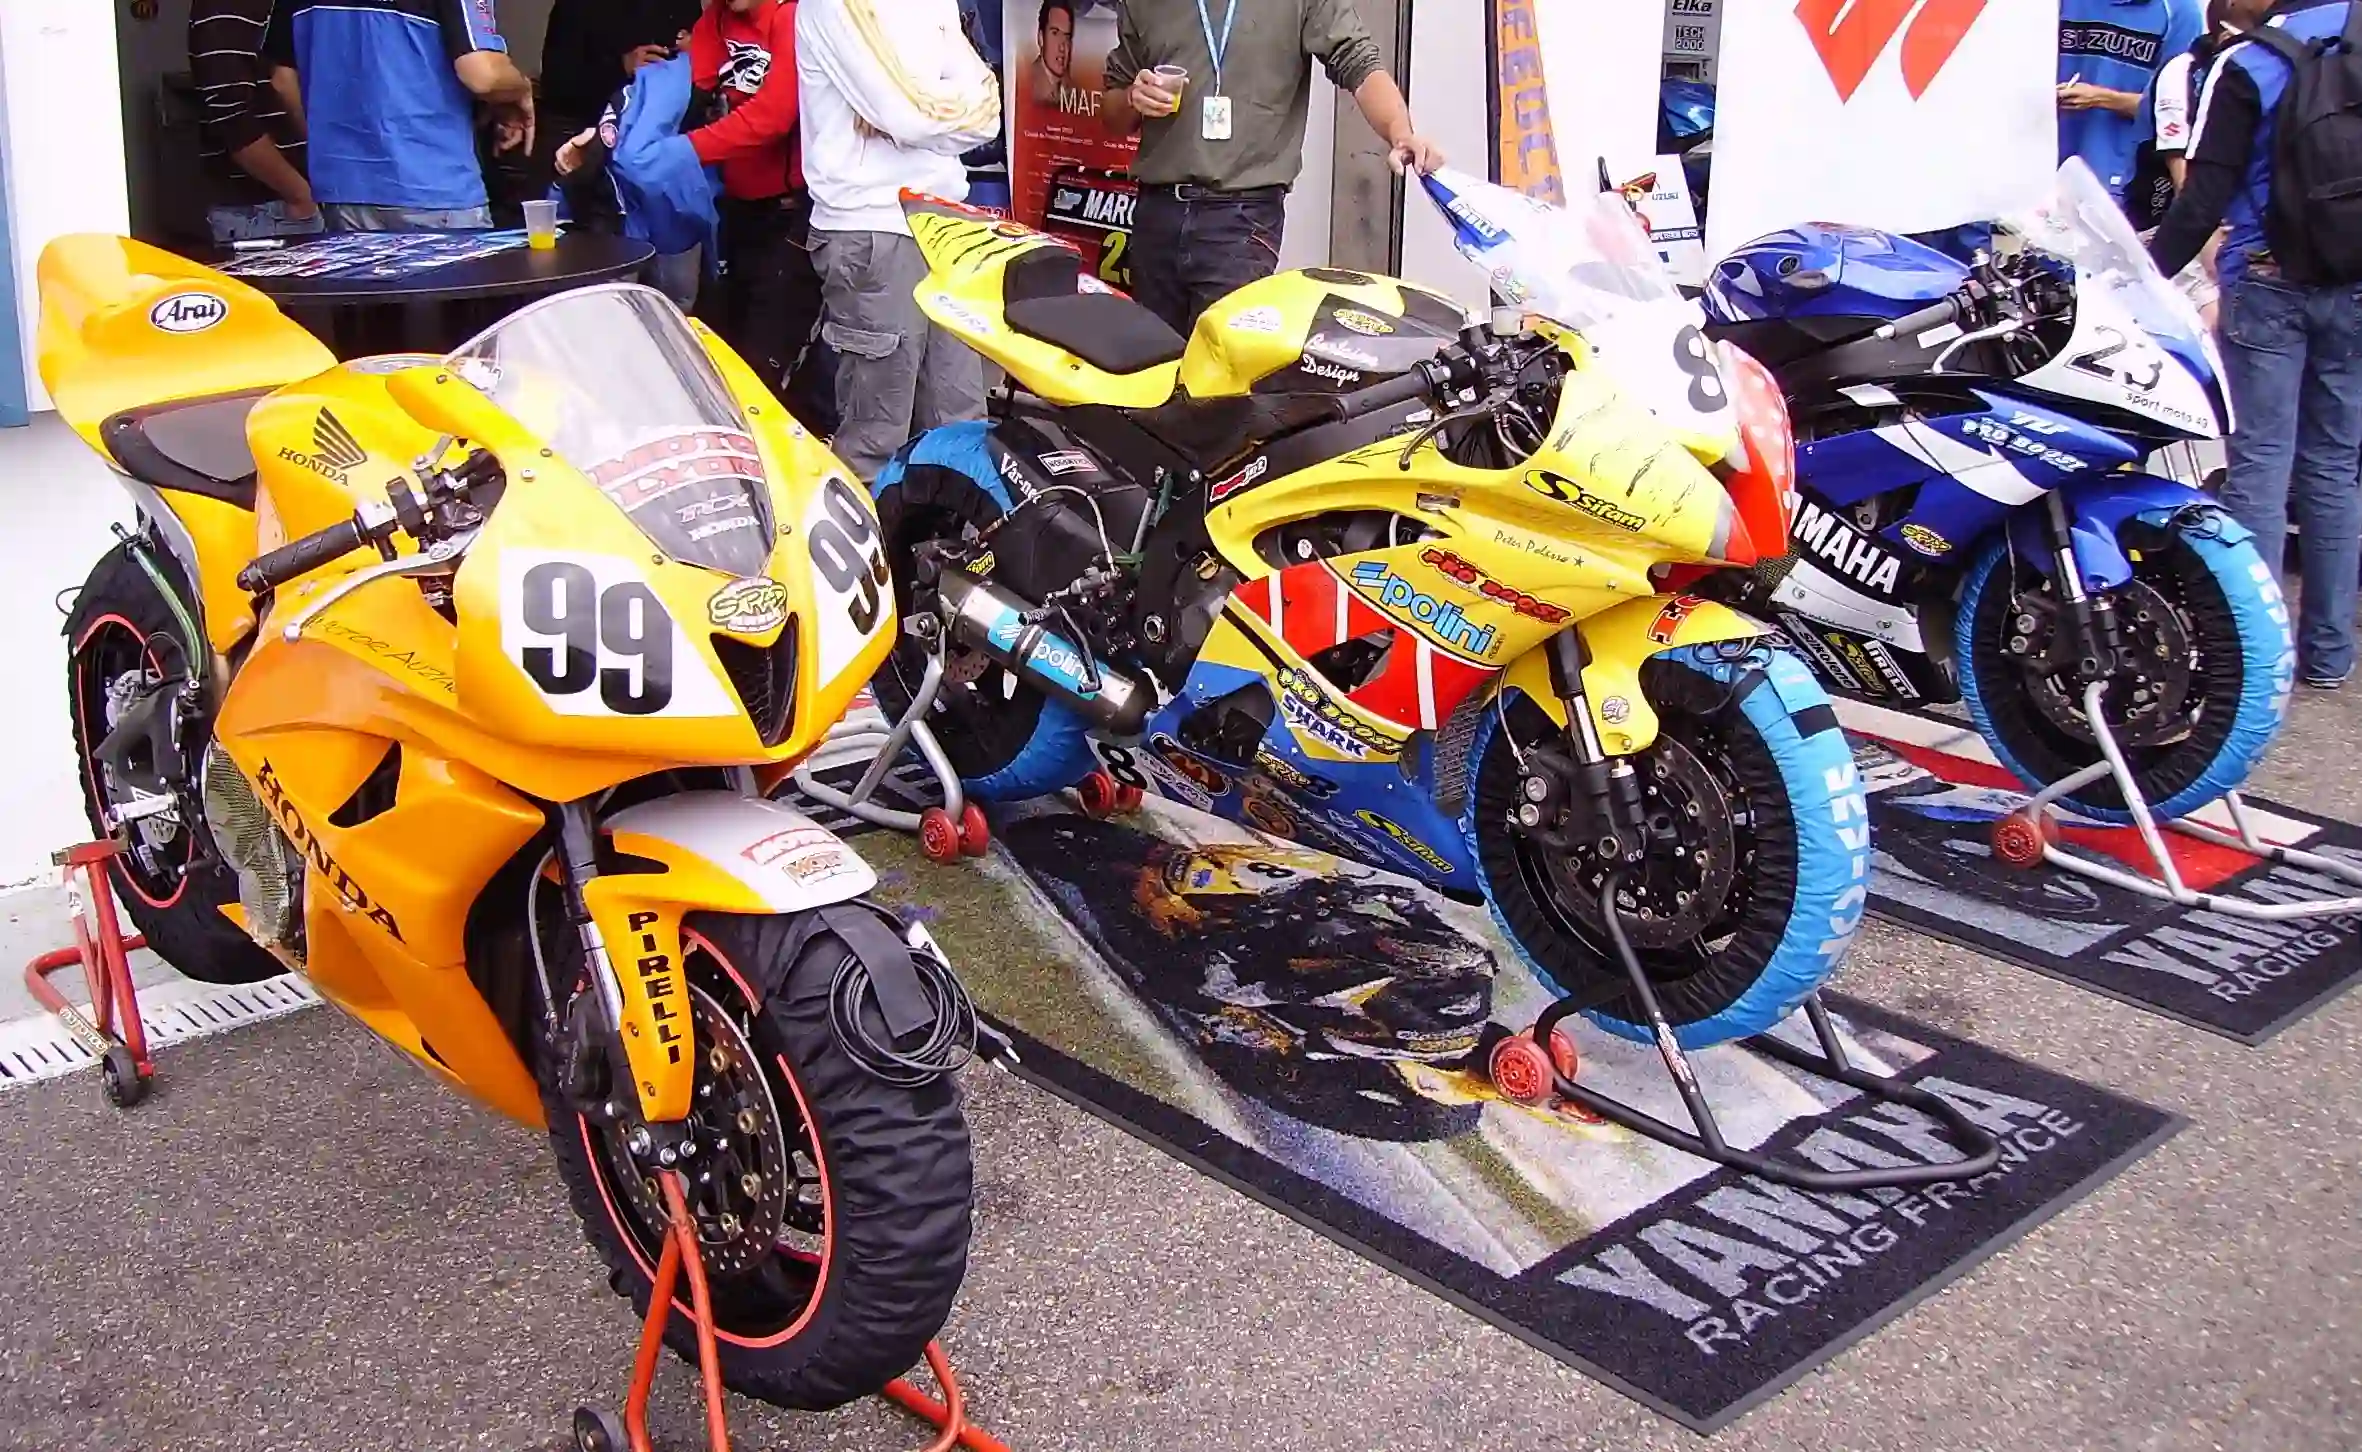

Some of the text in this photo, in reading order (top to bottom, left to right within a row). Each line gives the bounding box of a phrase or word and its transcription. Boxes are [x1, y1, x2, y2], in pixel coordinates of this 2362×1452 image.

[1675, 25, 1705, 38] TECH
[2060, 28, 2156, 62] SUZUKI
[155, 299, 217, 323] Arai
[1301, 353, 1360, 387] Design
[1673, 324, 1728, 413] 8
[2064, 325, 2163, 394] 23
[2125, 392, 2160, 413] sport
[2163, 405, 2192, 424] moto
[277, 447, 349, 487] HONDA
[687, 515, 760, 541] HONDA
[1575, 494, 1646, 531] sifam
[809, 476, 889, 636] 99
[1380, 570, 1497, 655] polini
[1479, 579, 1573, 624] BOOST
[522, 561, 673, 715] 99
[1283, 692, 1368, 758] SHARK
[1097, 742, 1148, 790] 8
[256, 756, 407, 945] HONDA
[628, 911, 682, 1065] PIRELLI
[2207, 929, 2342, 1003] RACING
[1684, 1223, 1899, 1355] RACING
